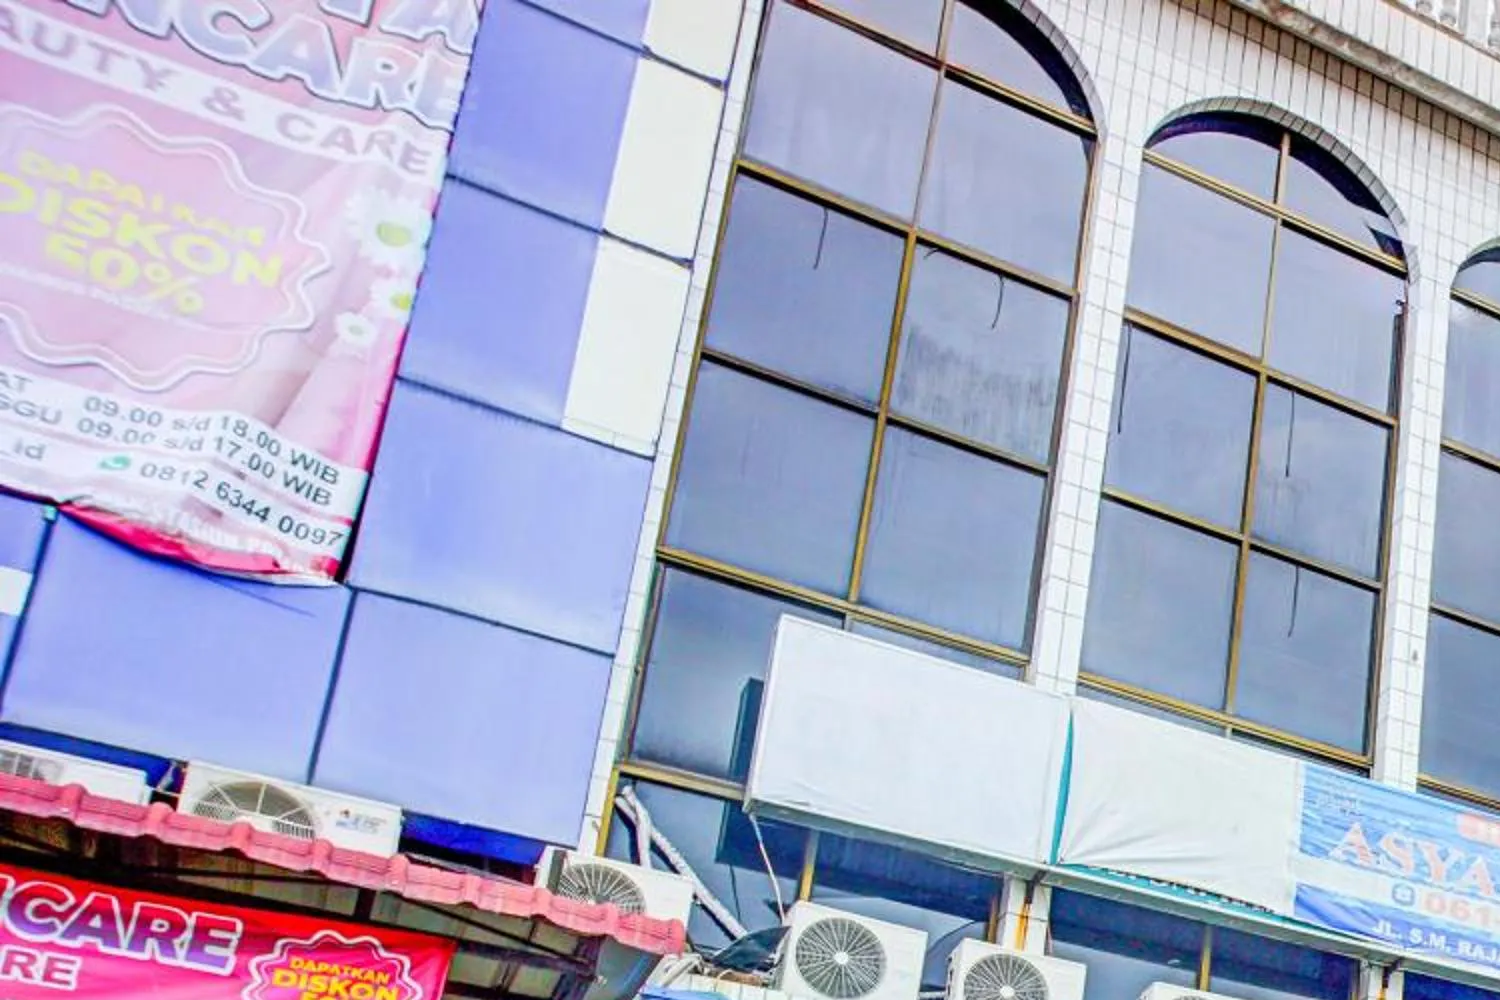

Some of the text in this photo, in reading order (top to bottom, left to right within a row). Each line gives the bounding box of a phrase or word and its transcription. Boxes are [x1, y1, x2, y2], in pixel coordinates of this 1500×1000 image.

[202, 86, 247, 122] &
[276, 112, 432, 175] CARE
[45, 232, 203, 316] 50%
[77, 417, 157, 445] 09.00
[163, 436, 204, 452] s/d
[213, 435, 275, 480] 17.00
[282, 470, 332, 506] WIB
[84, 395, 163, 428] 09.00
[171, 416, 212, 433] s/d
[220, 415, 282, 458] 18.00
[289, 447, 340, 486] WIB
[140, 461, 209, 490] 0812
[215, 480, 271, 523] 6344
[277, 514, 344, 546] 0097
[0, 874, 243, 977] CARE
[290, 956, 390, 984] DAPATKAN
